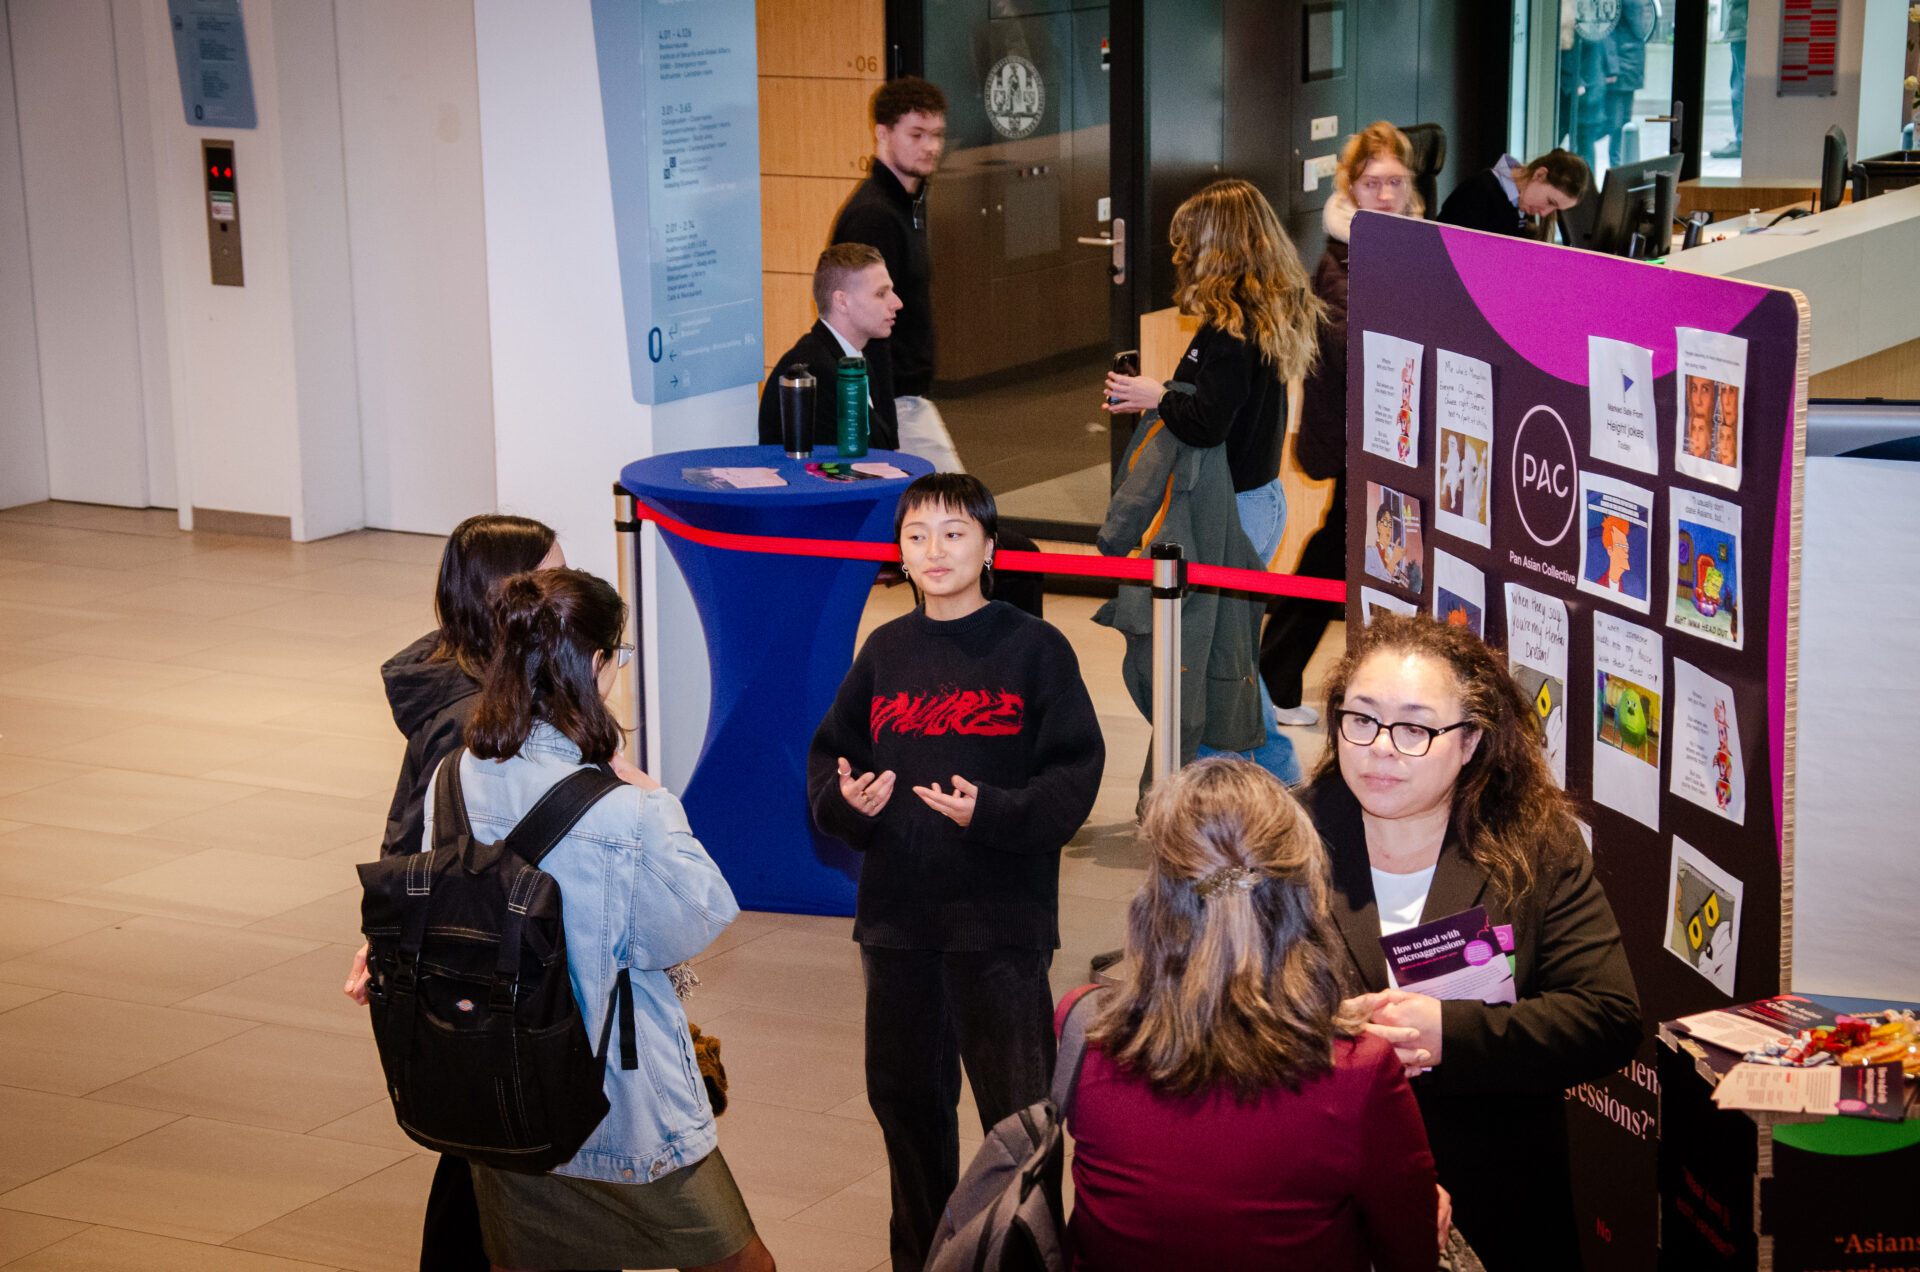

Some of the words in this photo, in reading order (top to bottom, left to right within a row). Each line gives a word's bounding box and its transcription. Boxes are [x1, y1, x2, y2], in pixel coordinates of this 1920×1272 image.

[855, 55, 877, 73] 06
[1623, 406, 1632, 416] Safe
[1633, 409, 1644, 419] From
[1606, 420, 1626, 438] Height
[1626, 424, 1645, 440] jokes
[1523, 453, 1568, 497] PAC
[1509, 551, 1522, 566] Pan
[1523, 555, 1541, 572] Asian
[1542, 562, 1576, 585] Collective
[1511, 592, 1529, 606] When
[1532, 597, 1546, 624] they
[1548, 607, 1562, 632] say
[1702, 624, 1716, 634] HEAD
[1717, 628, 1729, 638] OUT
[1392, 944, 1412, 956] How
[1412, 940, 1422, 950] to
[1422, 935, 1440, 947] deal
[1440, 929, 1460, 941] with
[1396, 938, 1466, 964] microaggressions
